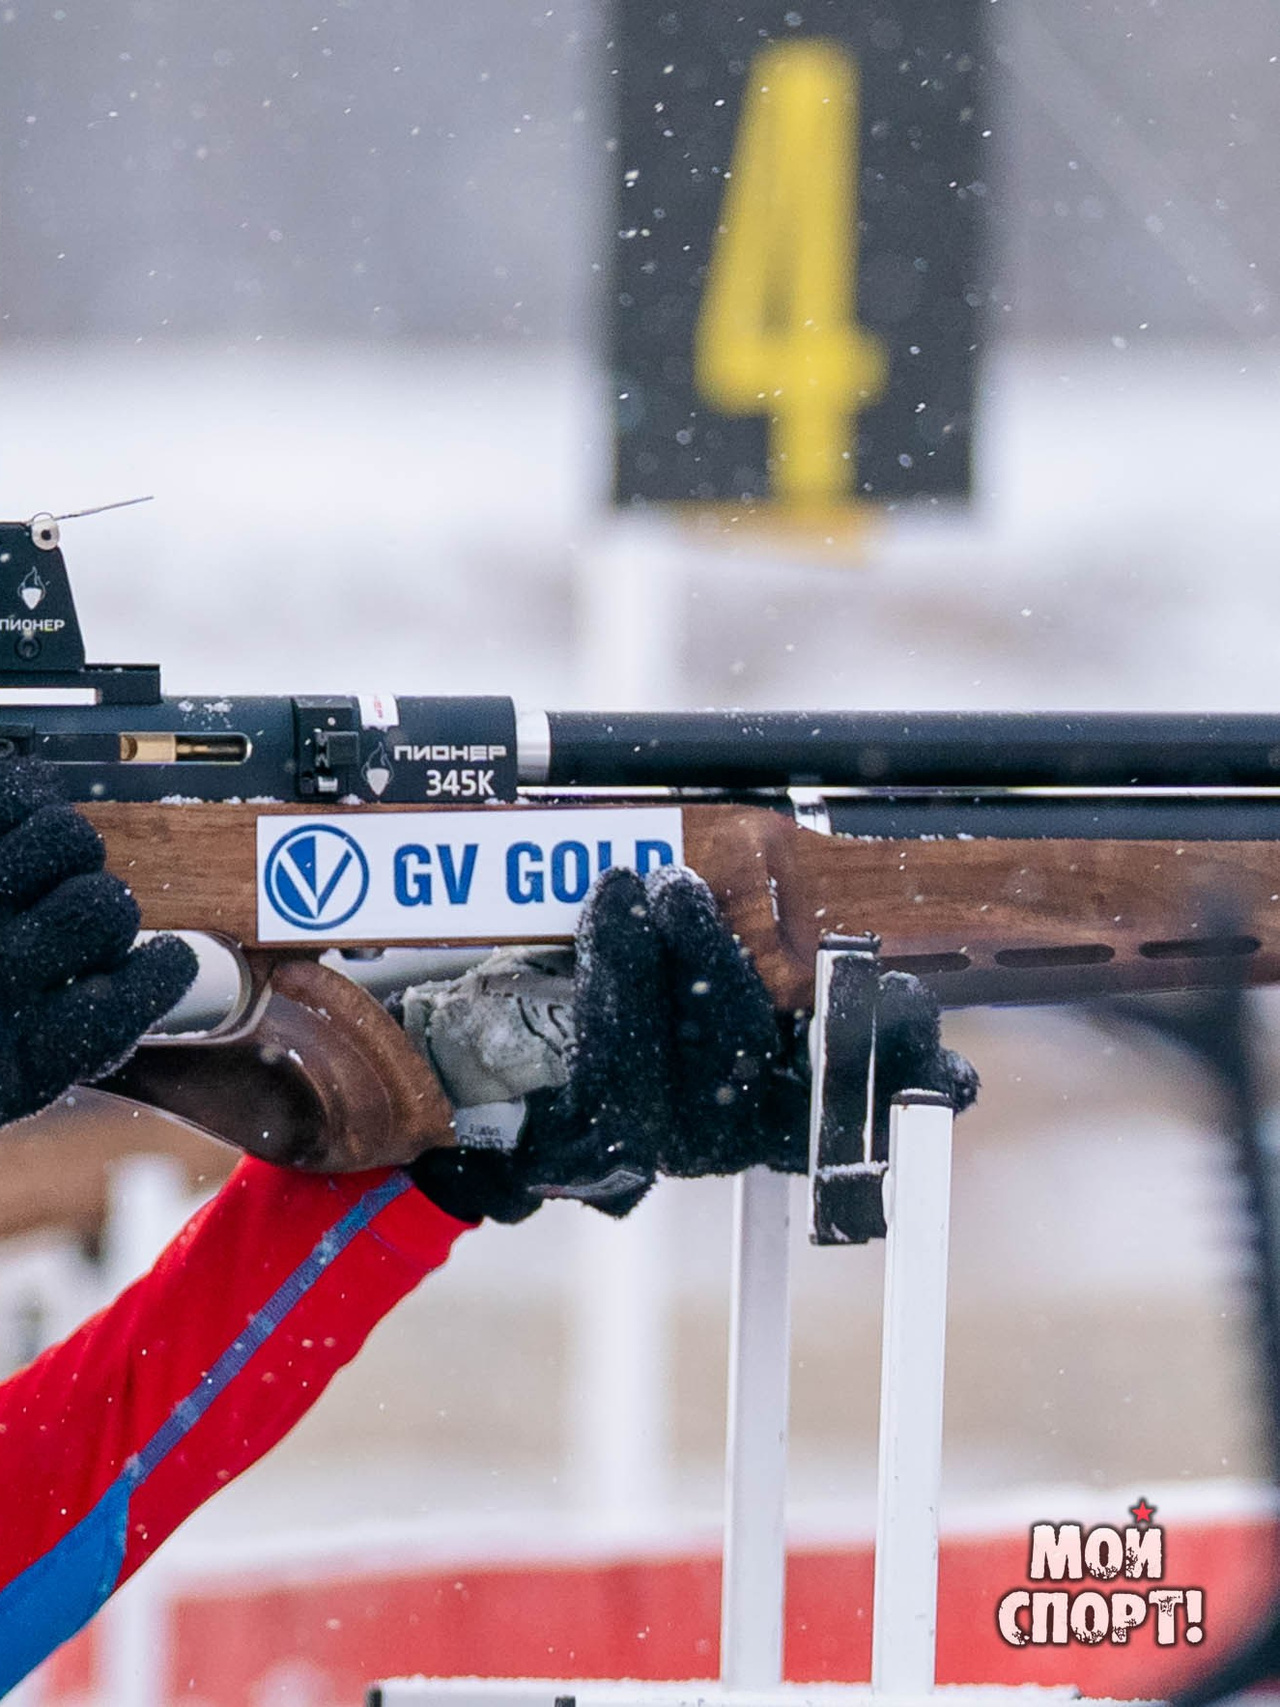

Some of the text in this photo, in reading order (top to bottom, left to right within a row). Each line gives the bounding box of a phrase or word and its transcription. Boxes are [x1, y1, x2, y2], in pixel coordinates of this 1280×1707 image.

[694, 38, 888, 510] 4
[394, 745, 507, 761] ПИОНЕР
[393, 843, 479, 906] GV
